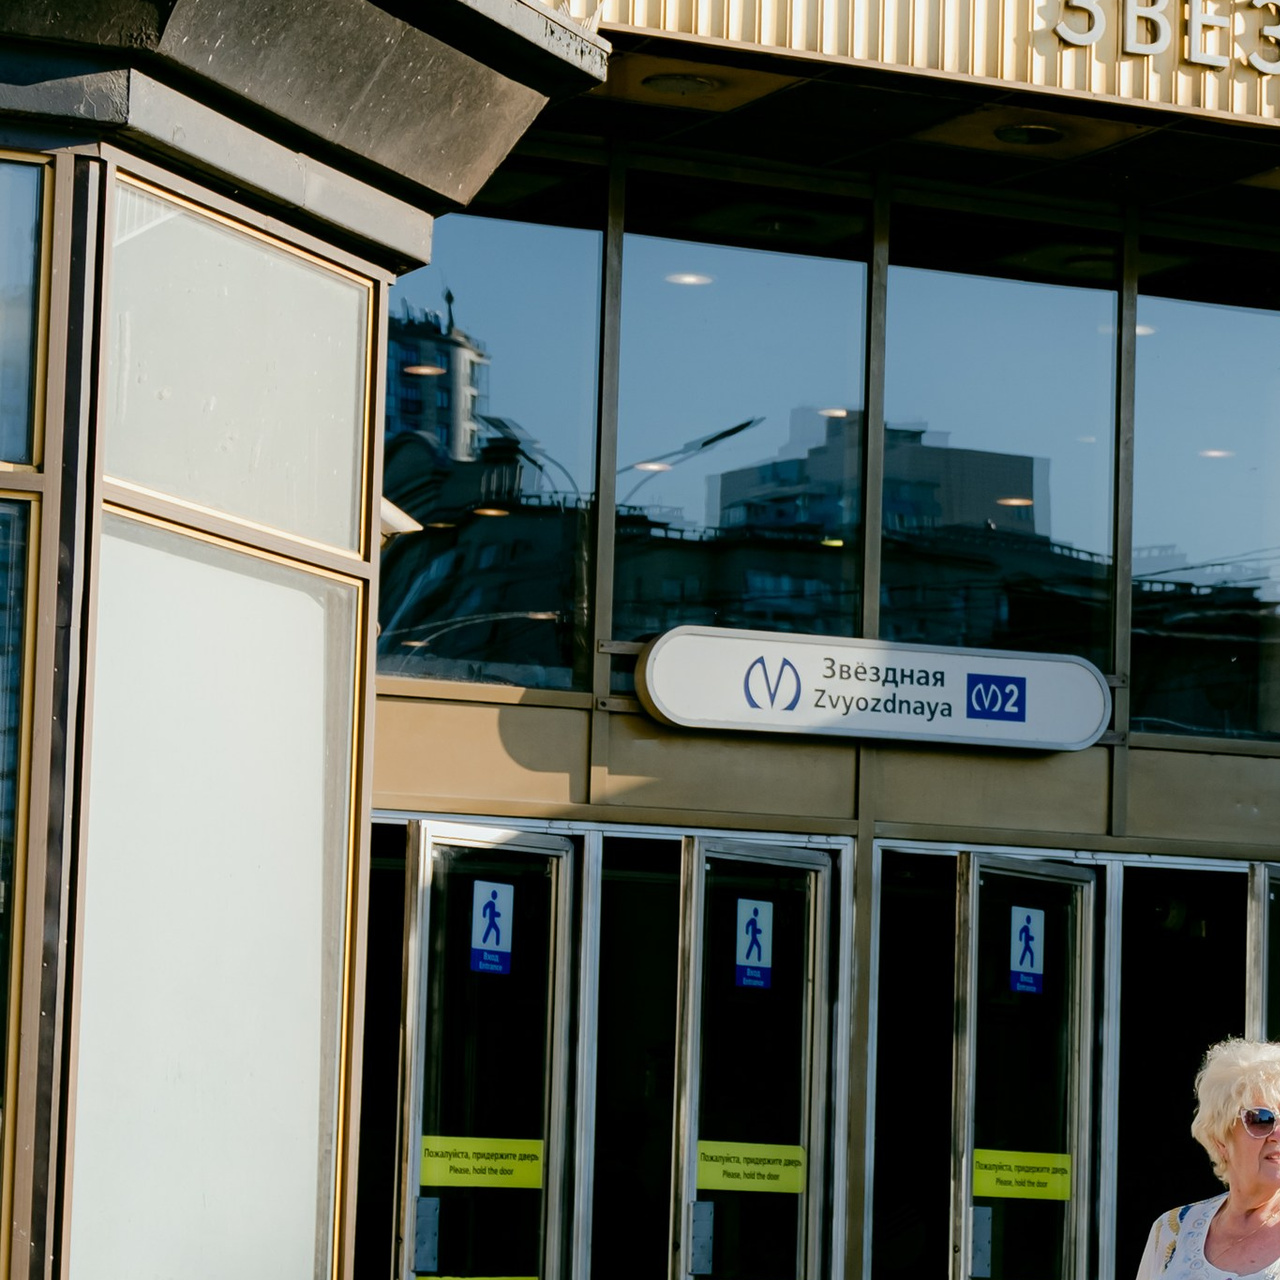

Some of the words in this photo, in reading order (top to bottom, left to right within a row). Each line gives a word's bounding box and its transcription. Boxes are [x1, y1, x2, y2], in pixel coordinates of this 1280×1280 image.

[822, 657, 946, 689] Звёздная
[813, 689, 953, 723] Zvyozdnaya
[483, 951, 499, 963] Вход
[424, 1148, 470, 1161] Пожалуйста,
[472, 1151, 517, 1162] придержите
[518, 1152, 540, 1163] дверь
[449, 1165, 471, 1175] Please,
[472, 1166, 487, 1175] hold
[488, 1166, 498, 1176] the
[499, 1166, 514, 1176] door
